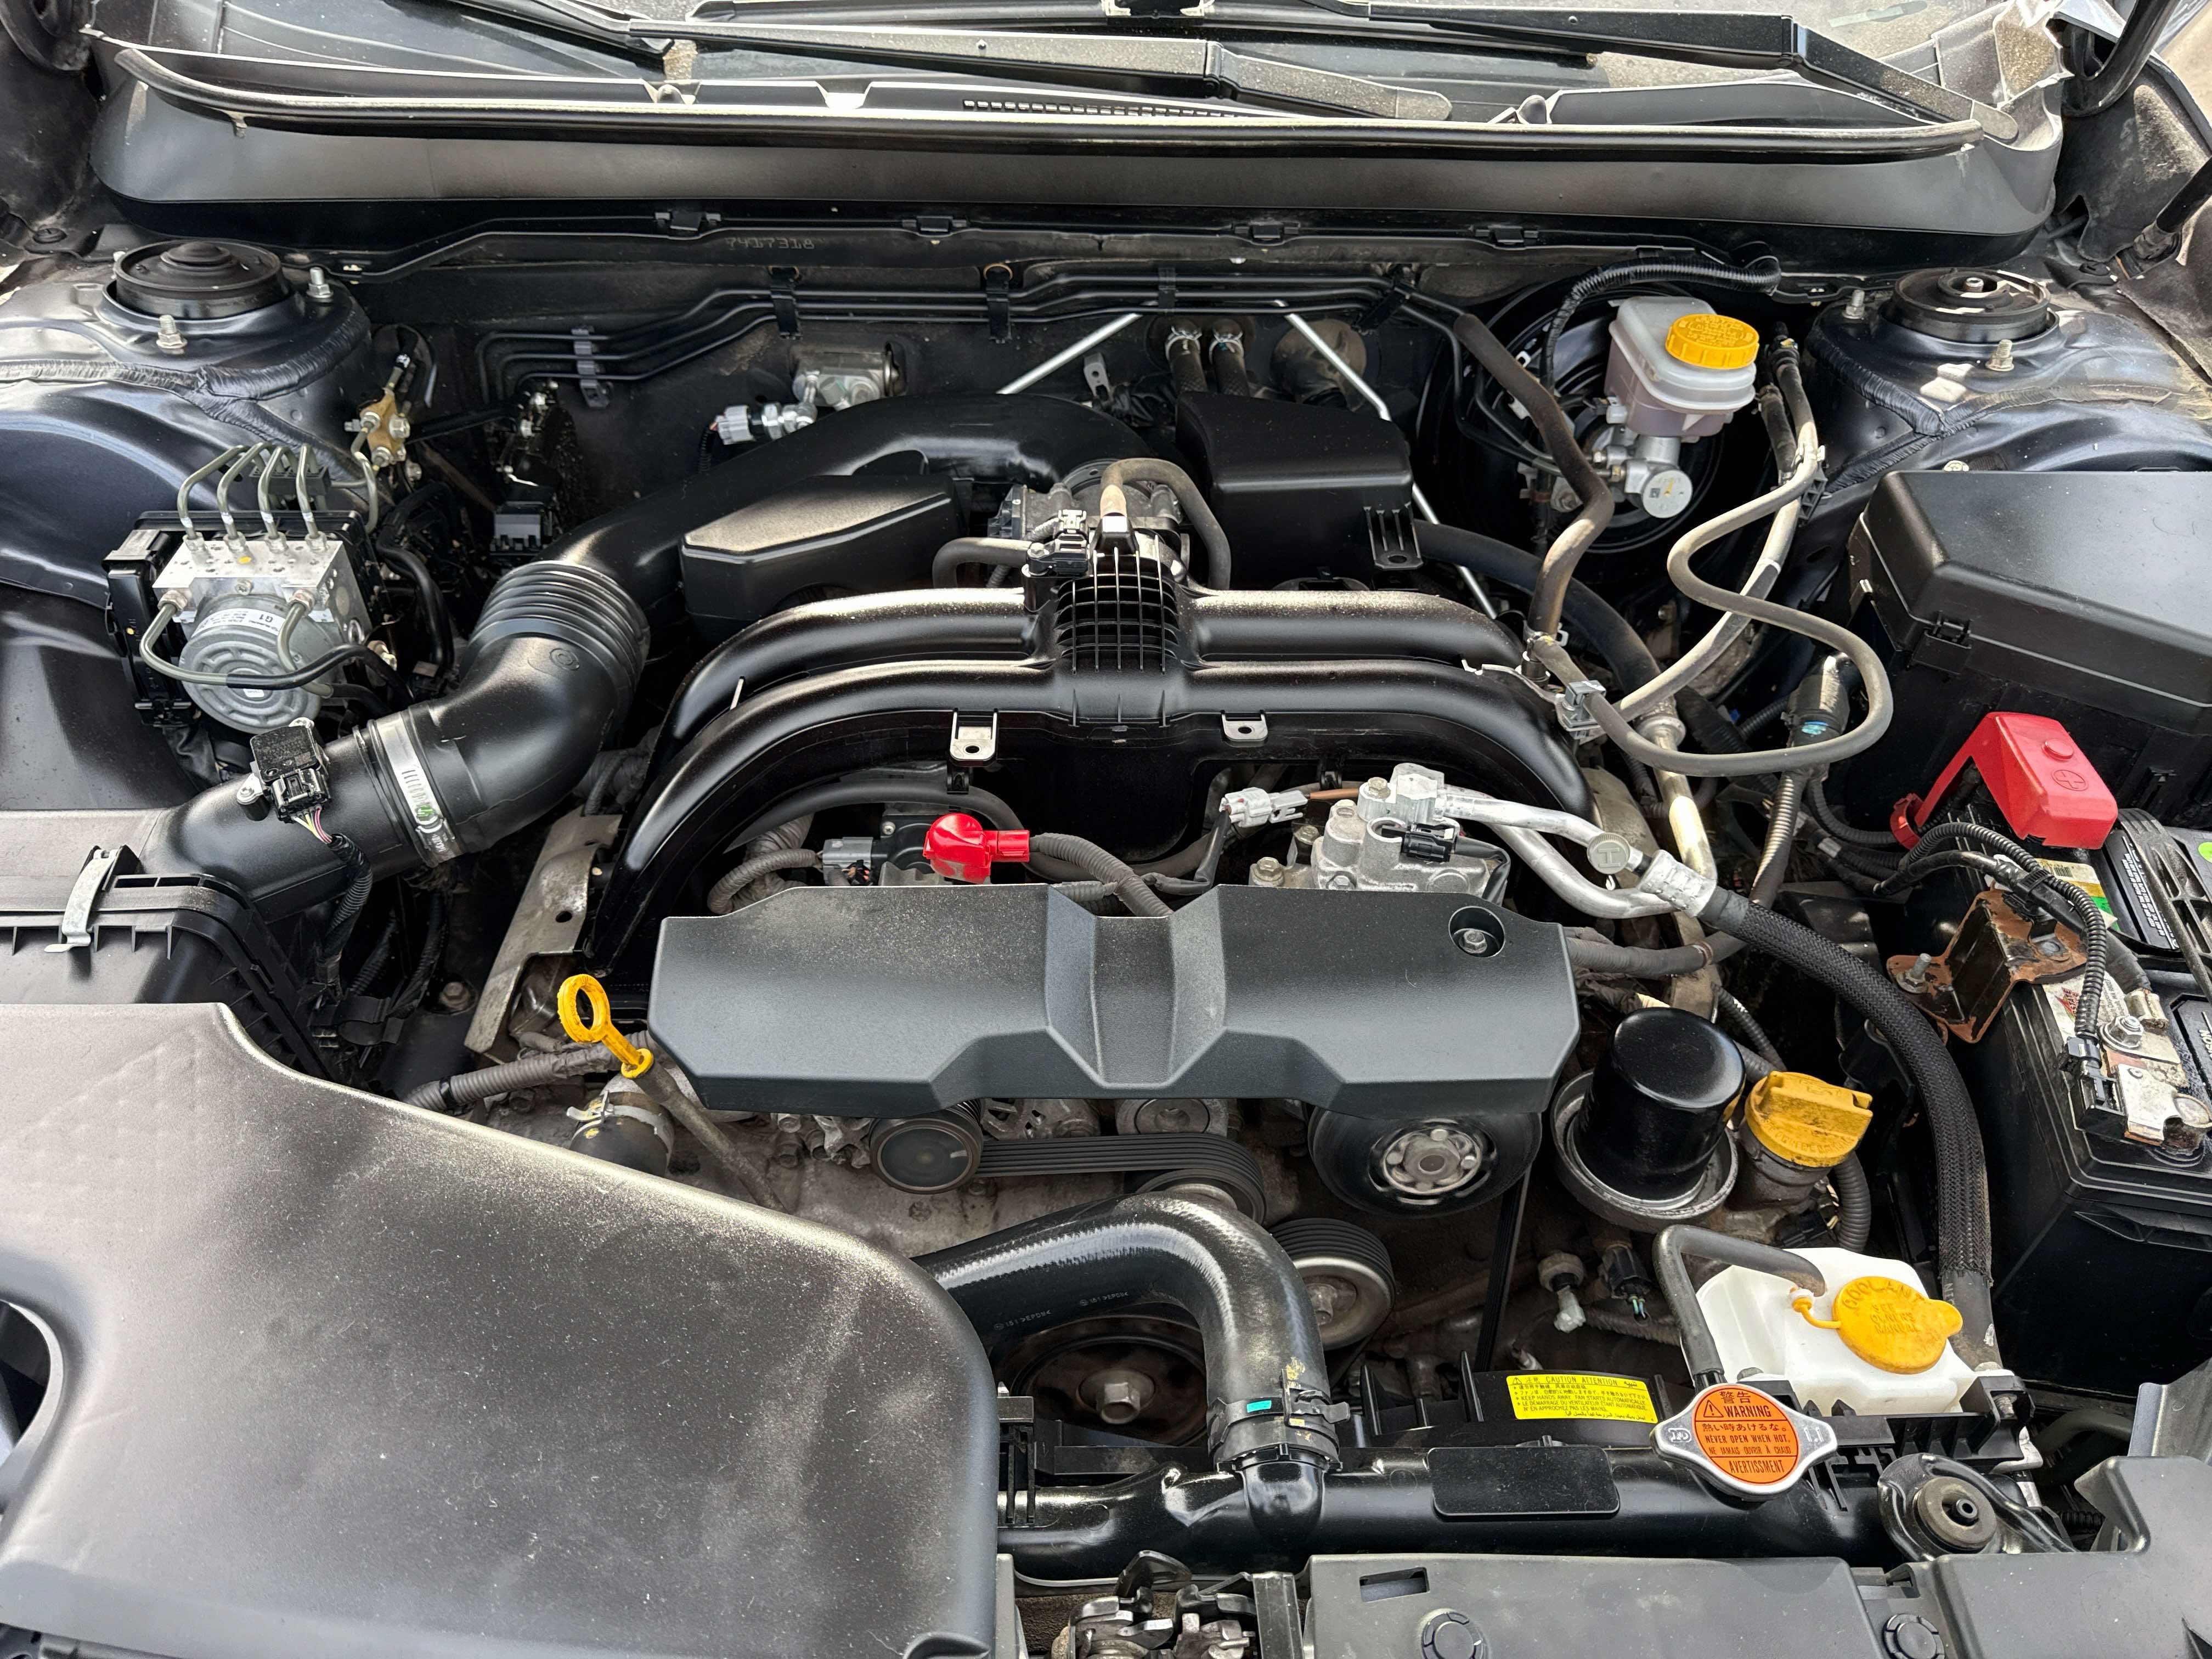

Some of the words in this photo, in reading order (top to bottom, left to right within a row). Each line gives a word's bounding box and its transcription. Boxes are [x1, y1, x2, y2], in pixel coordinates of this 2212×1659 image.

[258, 613, 274, 623] G1
[1842, 1280, 1925, 1309] COOLANT
[1875, 1324, 1921, 1335] MANUAL
[1582, 1377, 1618, 1386] ATTENTION
[1720, 1391, 1751, 1404] 警告
[1723, 1405, 1772, 1418] WARNING
[1730, 1435, 1749, 1443] OPEN
[1750, 1434, 1771, 1443] WHEN
[1708, 1447, 1717, 1455] NE
[1720, 1446, 1740, 1455] JAMAIS
[1744, 1446, 1762, 1455] OUVRIR
[1729, 1459, 1785, 1474] AVERTISSMENT
